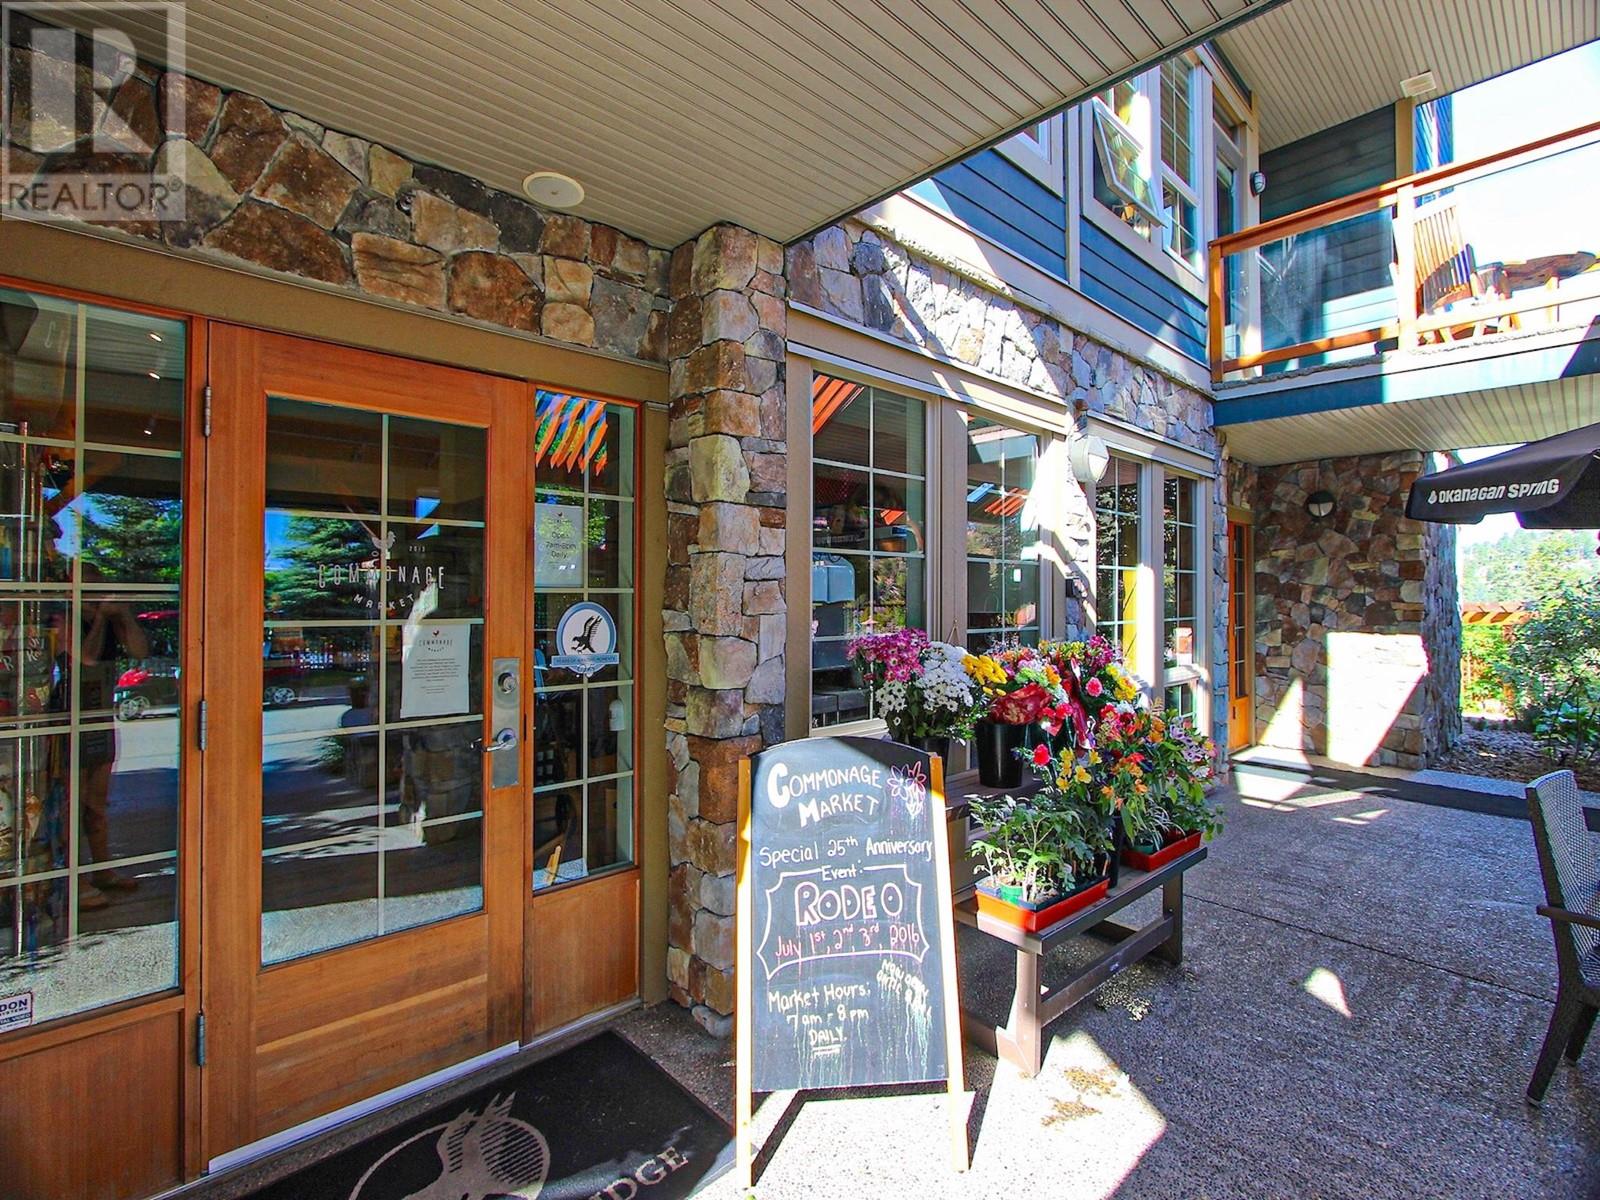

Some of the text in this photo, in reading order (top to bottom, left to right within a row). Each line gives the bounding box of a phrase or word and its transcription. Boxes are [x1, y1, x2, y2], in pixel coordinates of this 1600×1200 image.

[318, 561, 446, 590] COMMONAGE
[767, 762, 882, 809] COMMONAGE
[798, 792, 879, 828] MARKET
[759, 835, 932, 869] Special 25th Anniversary
[794, 881, 903, 926] RODEO
[775, 935, 802, 958] July
[889, 923, 920, 946] 2016
[768, 988, 819, 1013] Market
